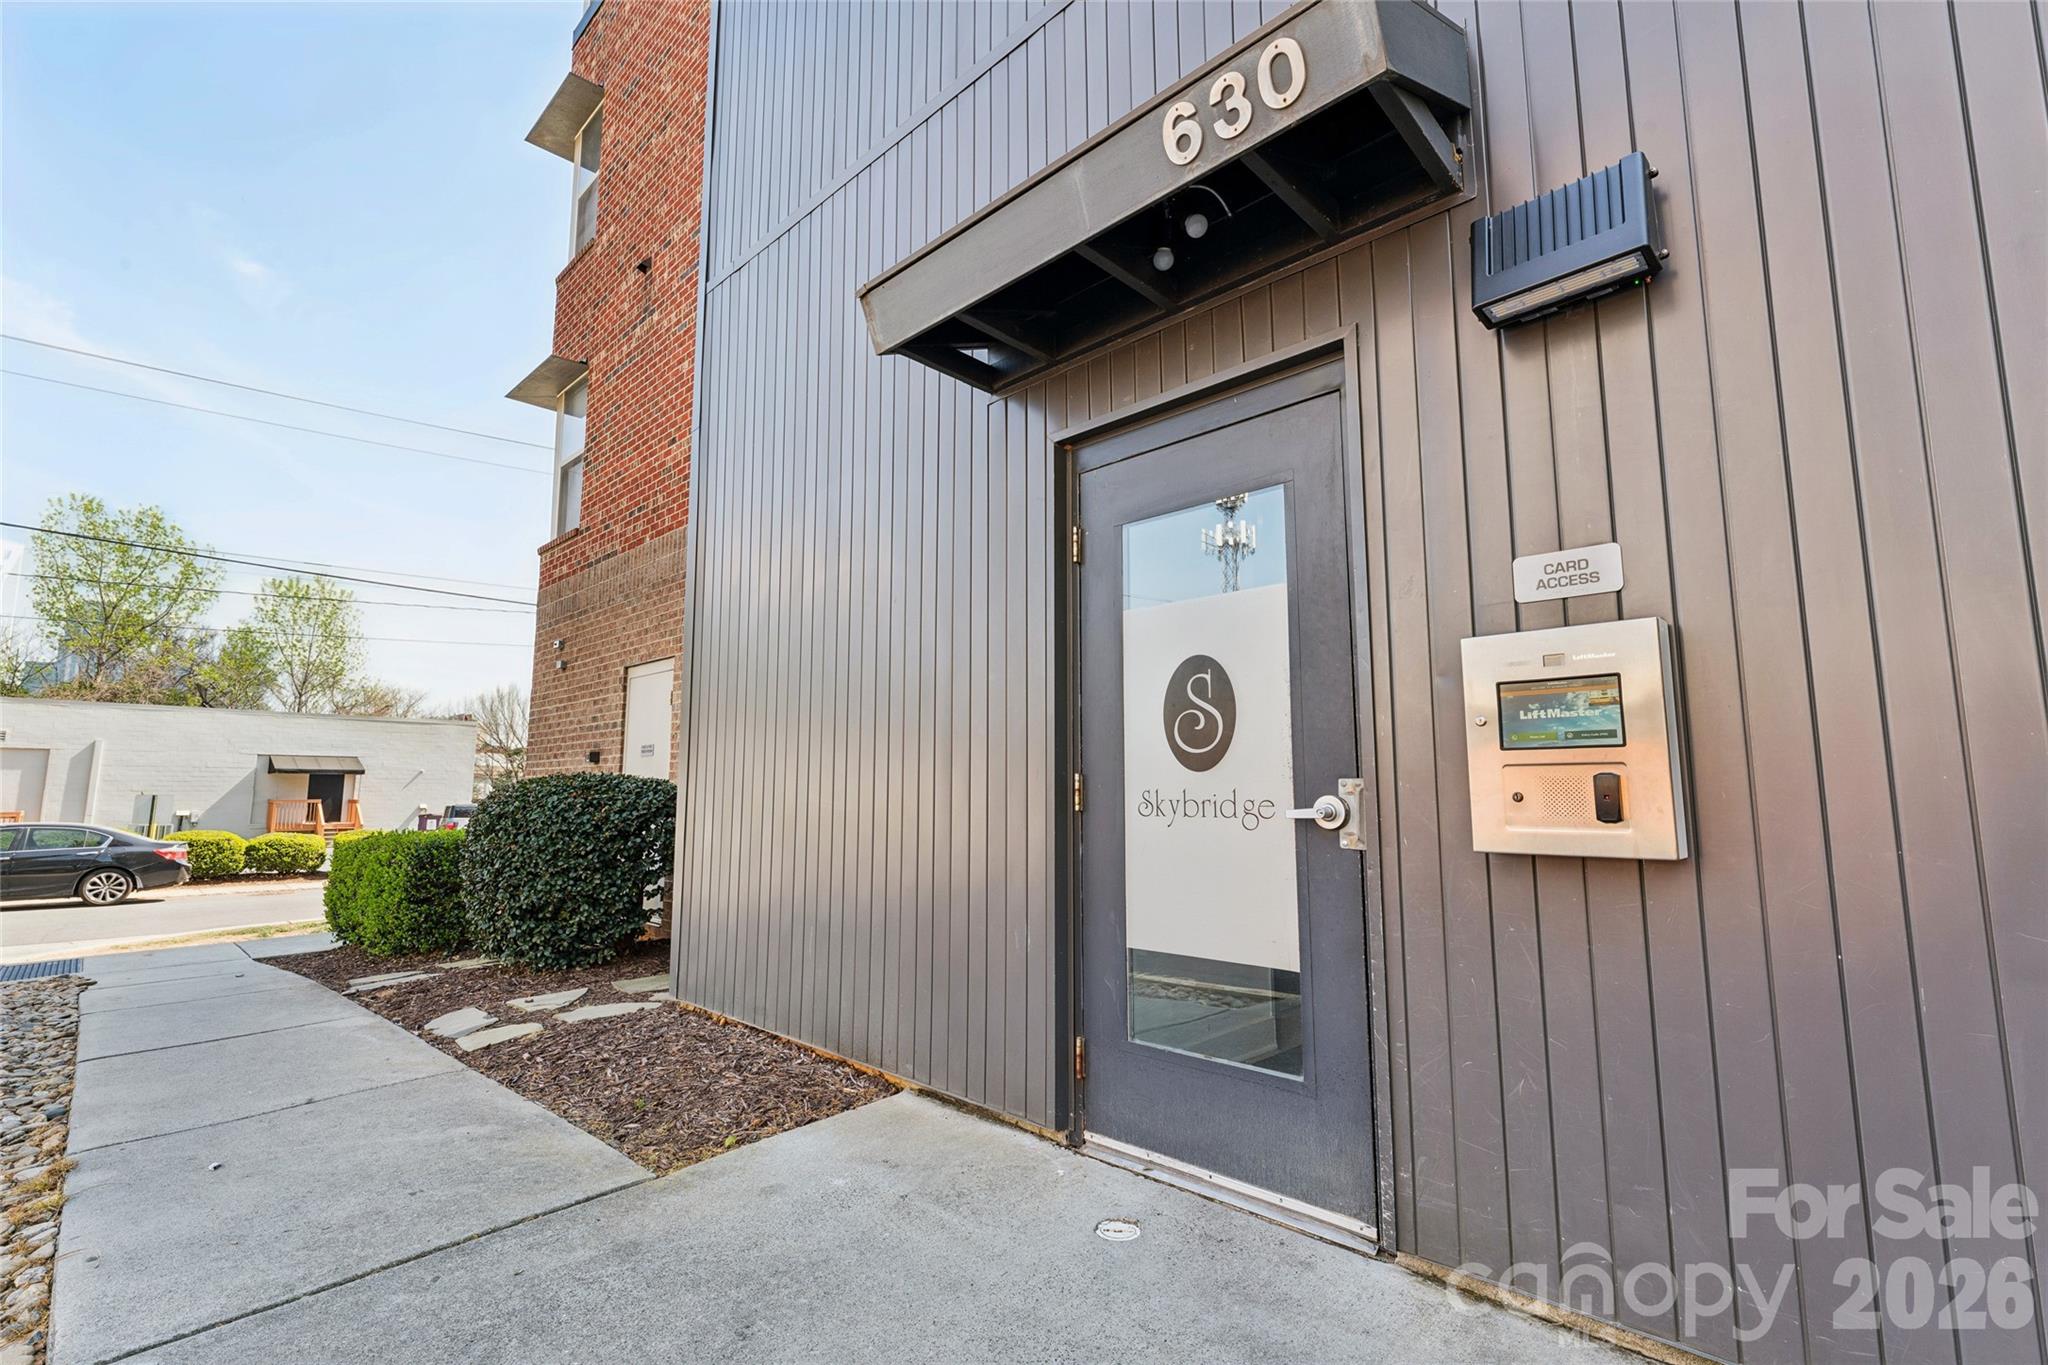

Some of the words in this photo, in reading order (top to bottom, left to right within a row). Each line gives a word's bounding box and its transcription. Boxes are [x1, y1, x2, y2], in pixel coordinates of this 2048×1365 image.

[1163, 37, 1306, 166] 630
[1535, 571, 1601, 591] ACCESS
[1543, 558, 1589, 576] CARD
[1173, 668, 1224, 754] S
[1519, 707, 1602, 720] LiftMaster
[1137, 787, 1276, 831] Skybridge
